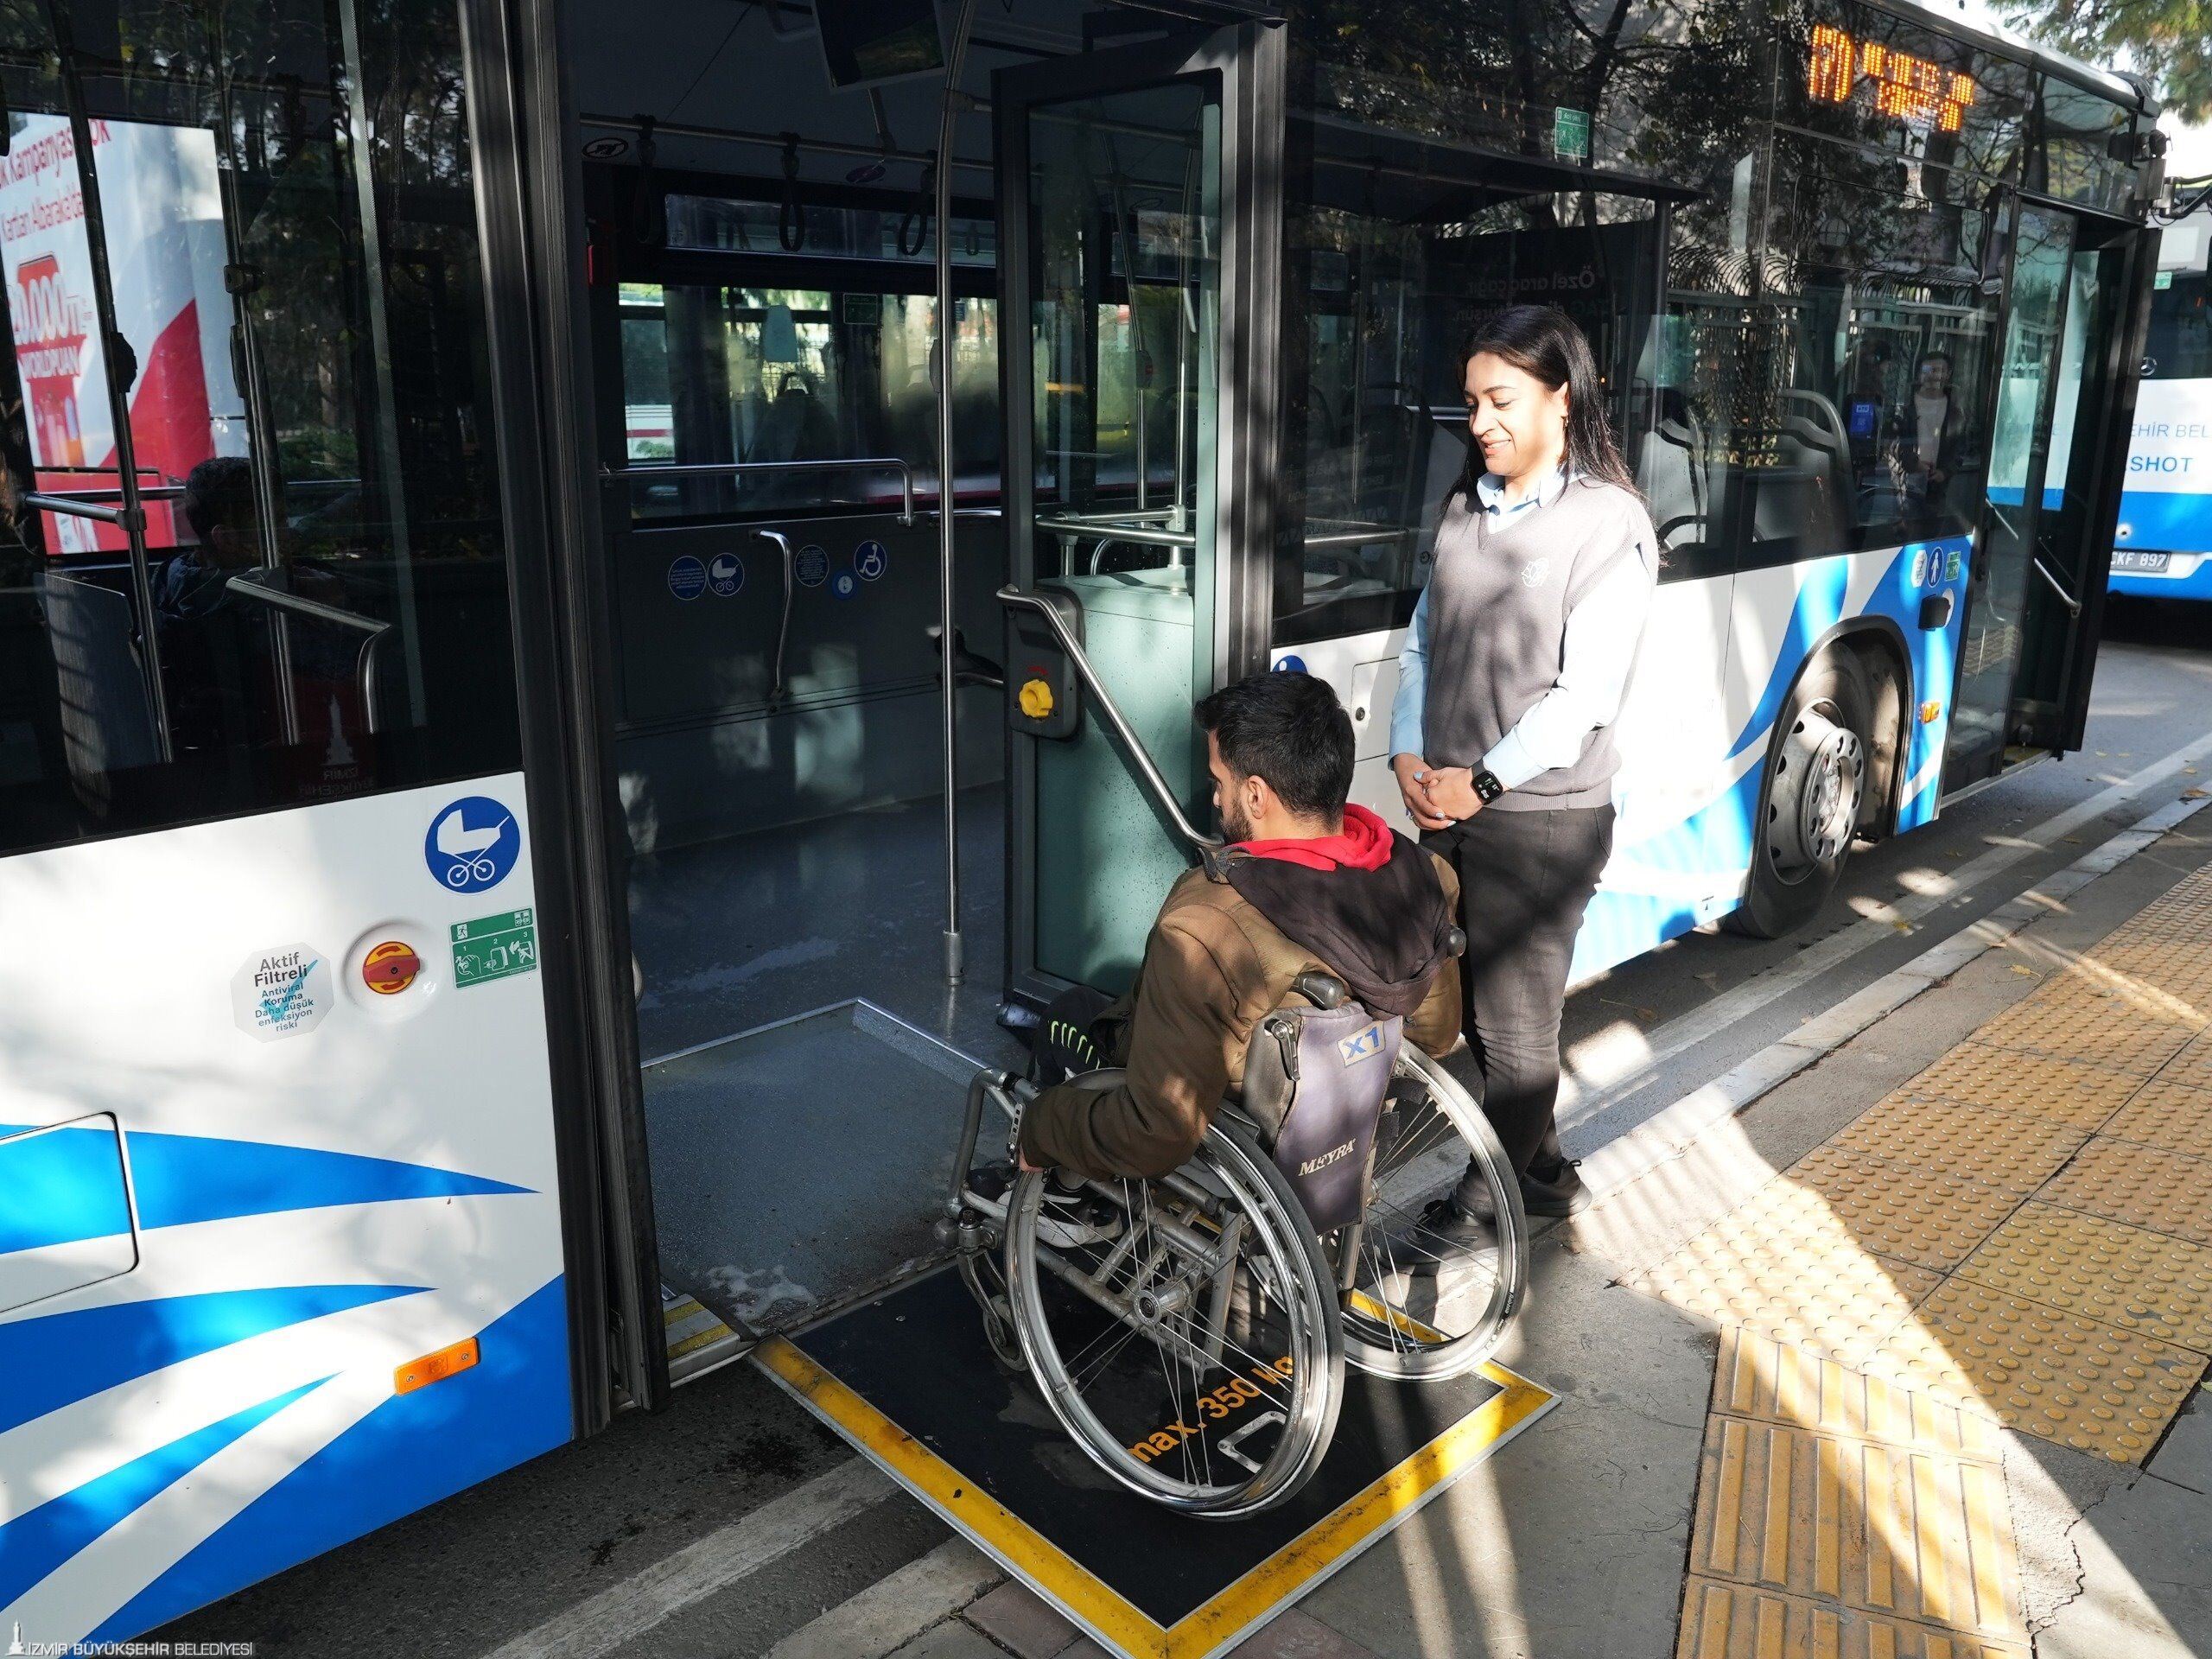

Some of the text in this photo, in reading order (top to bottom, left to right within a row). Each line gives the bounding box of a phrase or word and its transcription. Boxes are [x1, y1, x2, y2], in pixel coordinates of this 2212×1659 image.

[2139, 553, 2167, 567] 897
[260, 951, 300, 972] Aktif
[254, 964, 308, 987] Filtreli
[261, 982, 304, 998] Antiviral
[255, 999, 314, 1018] Daha düşük
[264, 993, 303, 1007] Koruma
[258, 1008, 313, 1027] enfeksiyon
[276, 1020, 298, 1032] riski
[1343, 1026, 1380, 1059] X1
[1298, 1141, 1356, 1177] MEYRA
[1196, 1377, 1262, 1419] 350
